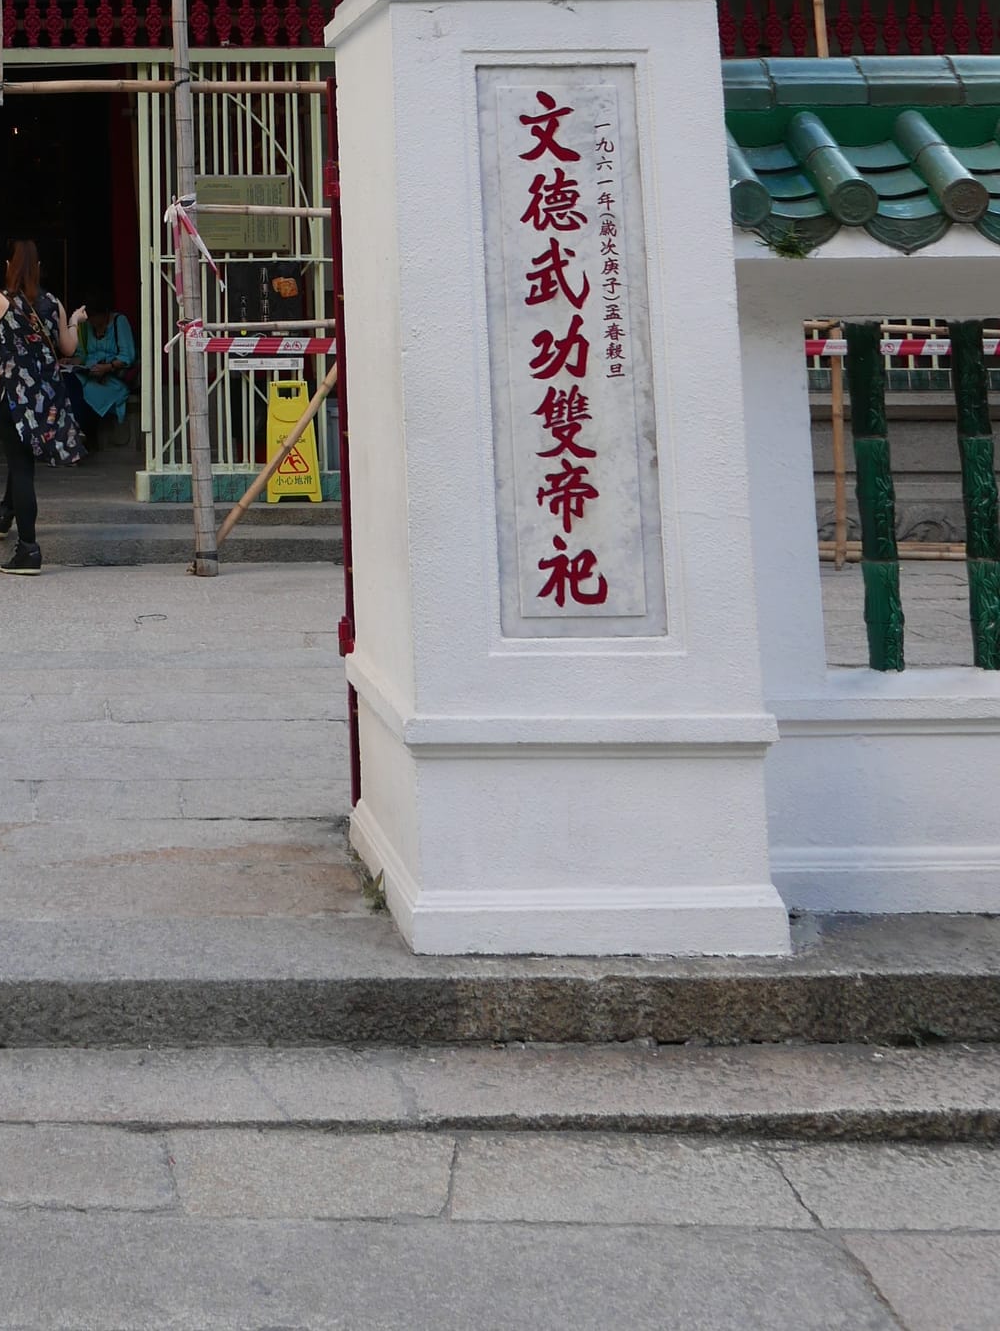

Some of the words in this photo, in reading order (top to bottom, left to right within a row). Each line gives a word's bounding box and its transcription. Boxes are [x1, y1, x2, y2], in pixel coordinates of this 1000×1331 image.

[275, 475, 313, 485] 小心地滑
[518, 90, 608, 607] 文德武功雙帝祀
